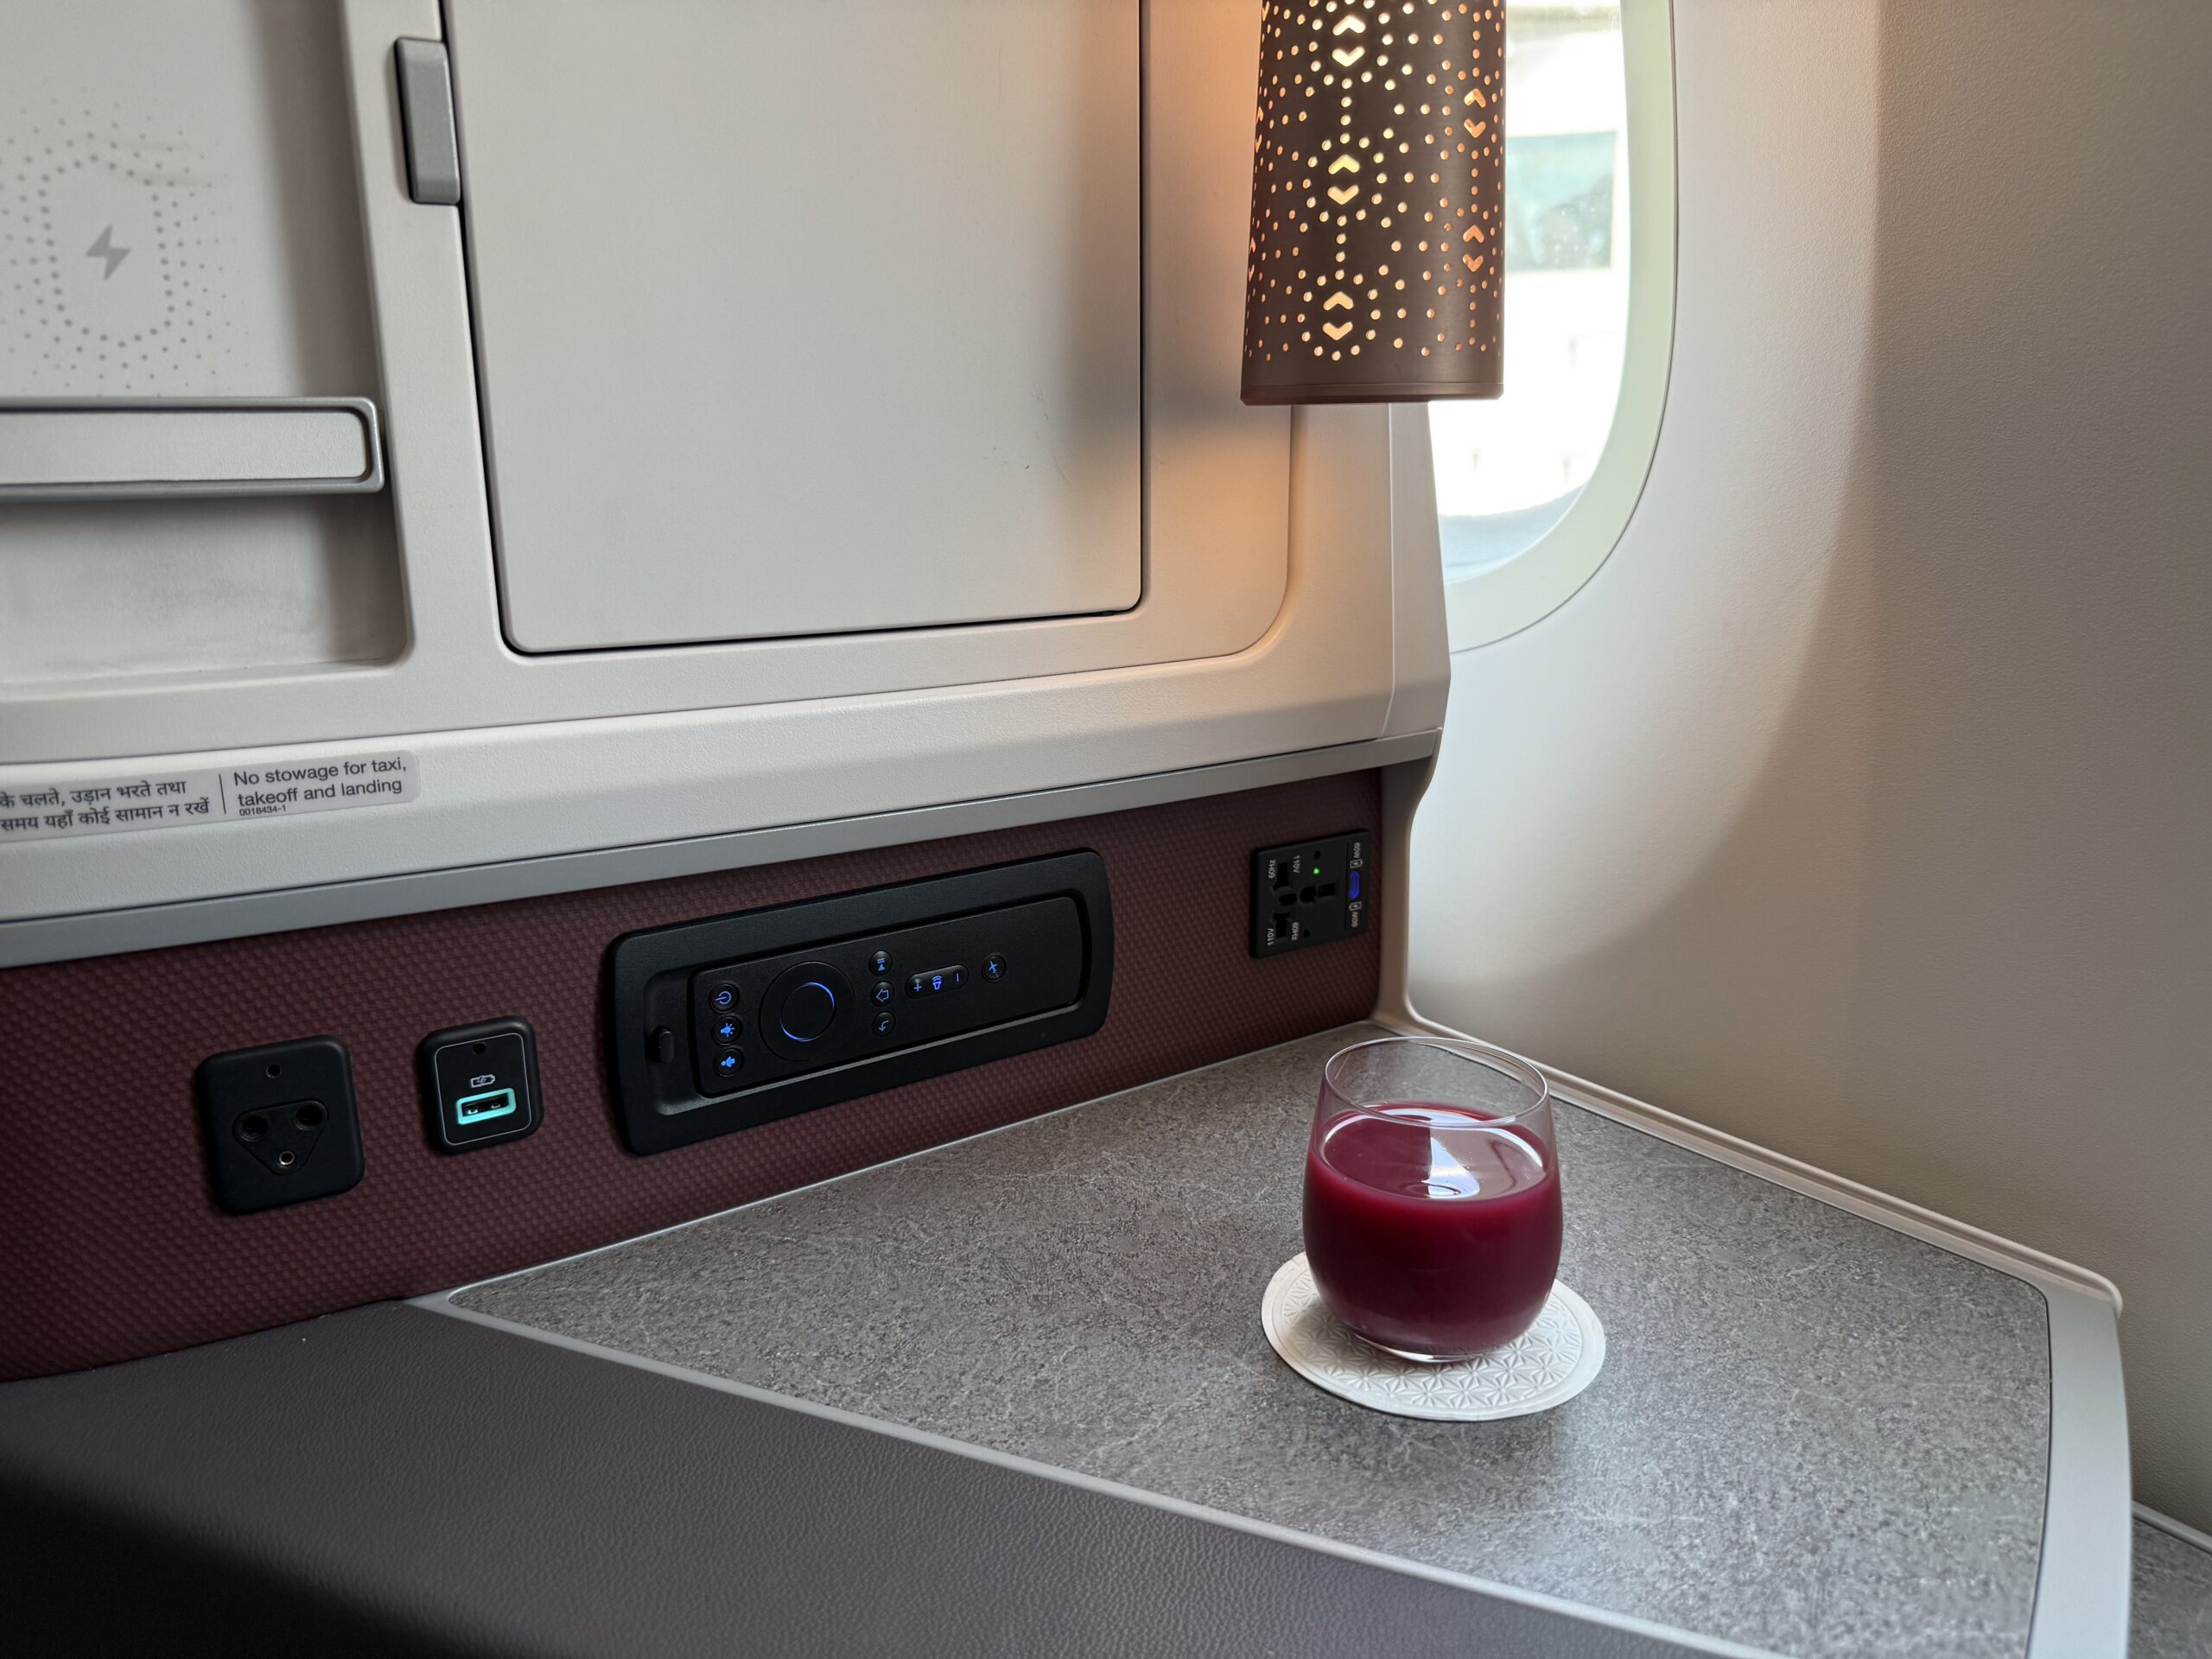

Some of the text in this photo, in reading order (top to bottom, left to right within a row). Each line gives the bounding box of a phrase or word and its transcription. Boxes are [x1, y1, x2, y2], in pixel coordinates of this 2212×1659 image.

[233, 757, 407, 786] No stowage for taxi,
[21, 788, 66, 806] चलते,
[71, 787, 111, 805] उड़ान
[118, 780, 150, 798] भरते
[156, 781, 187, 796] तथा
[238, 779, 403, 807] takeoff and landing
[1, 797, 210, 831] समय यहाँ कोई सामान न रखें
